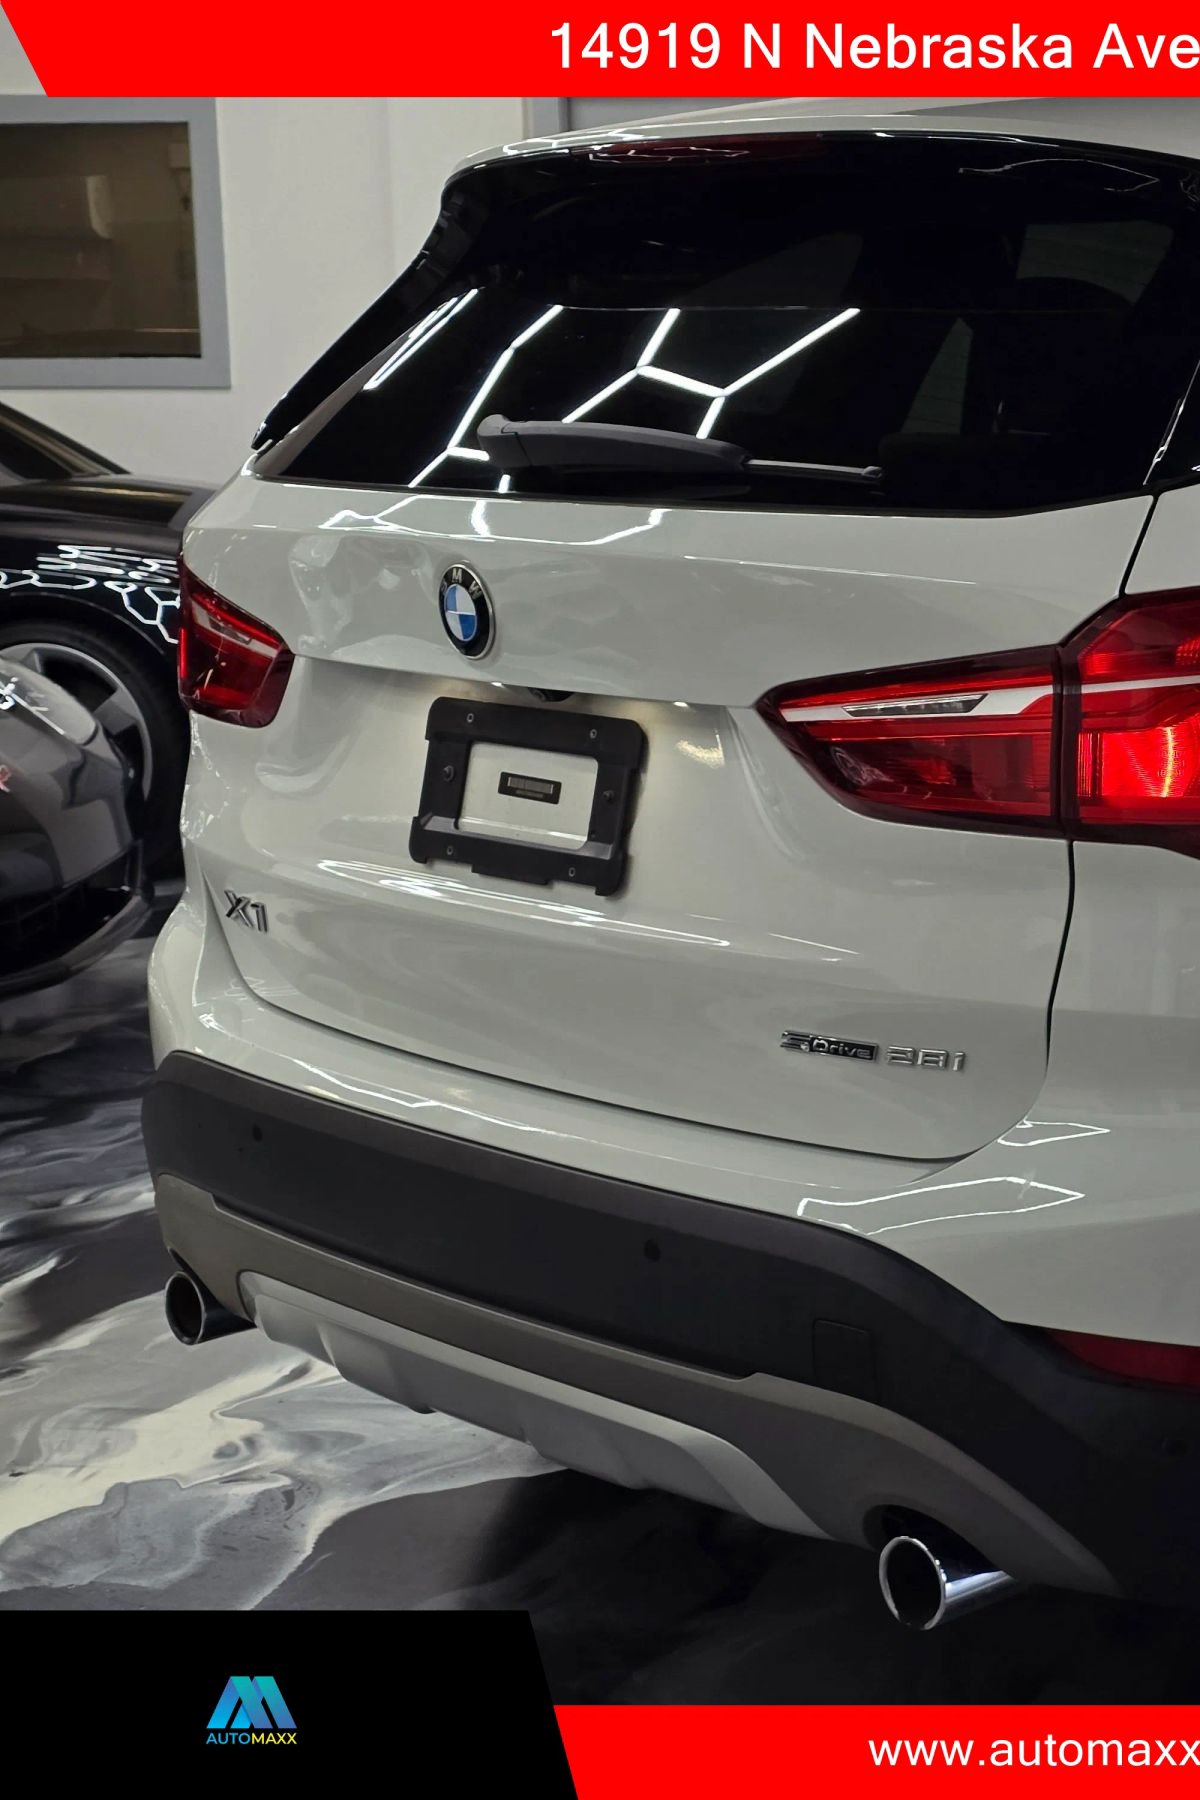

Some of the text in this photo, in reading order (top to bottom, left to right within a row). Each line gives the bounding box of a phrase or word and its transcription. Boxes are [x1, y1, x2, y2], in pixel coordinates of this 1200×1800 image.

[440, 567, 482, 600] BMW
[223, 890, 268, 933] X1
[886, 1044, 966, 1072] 28i
